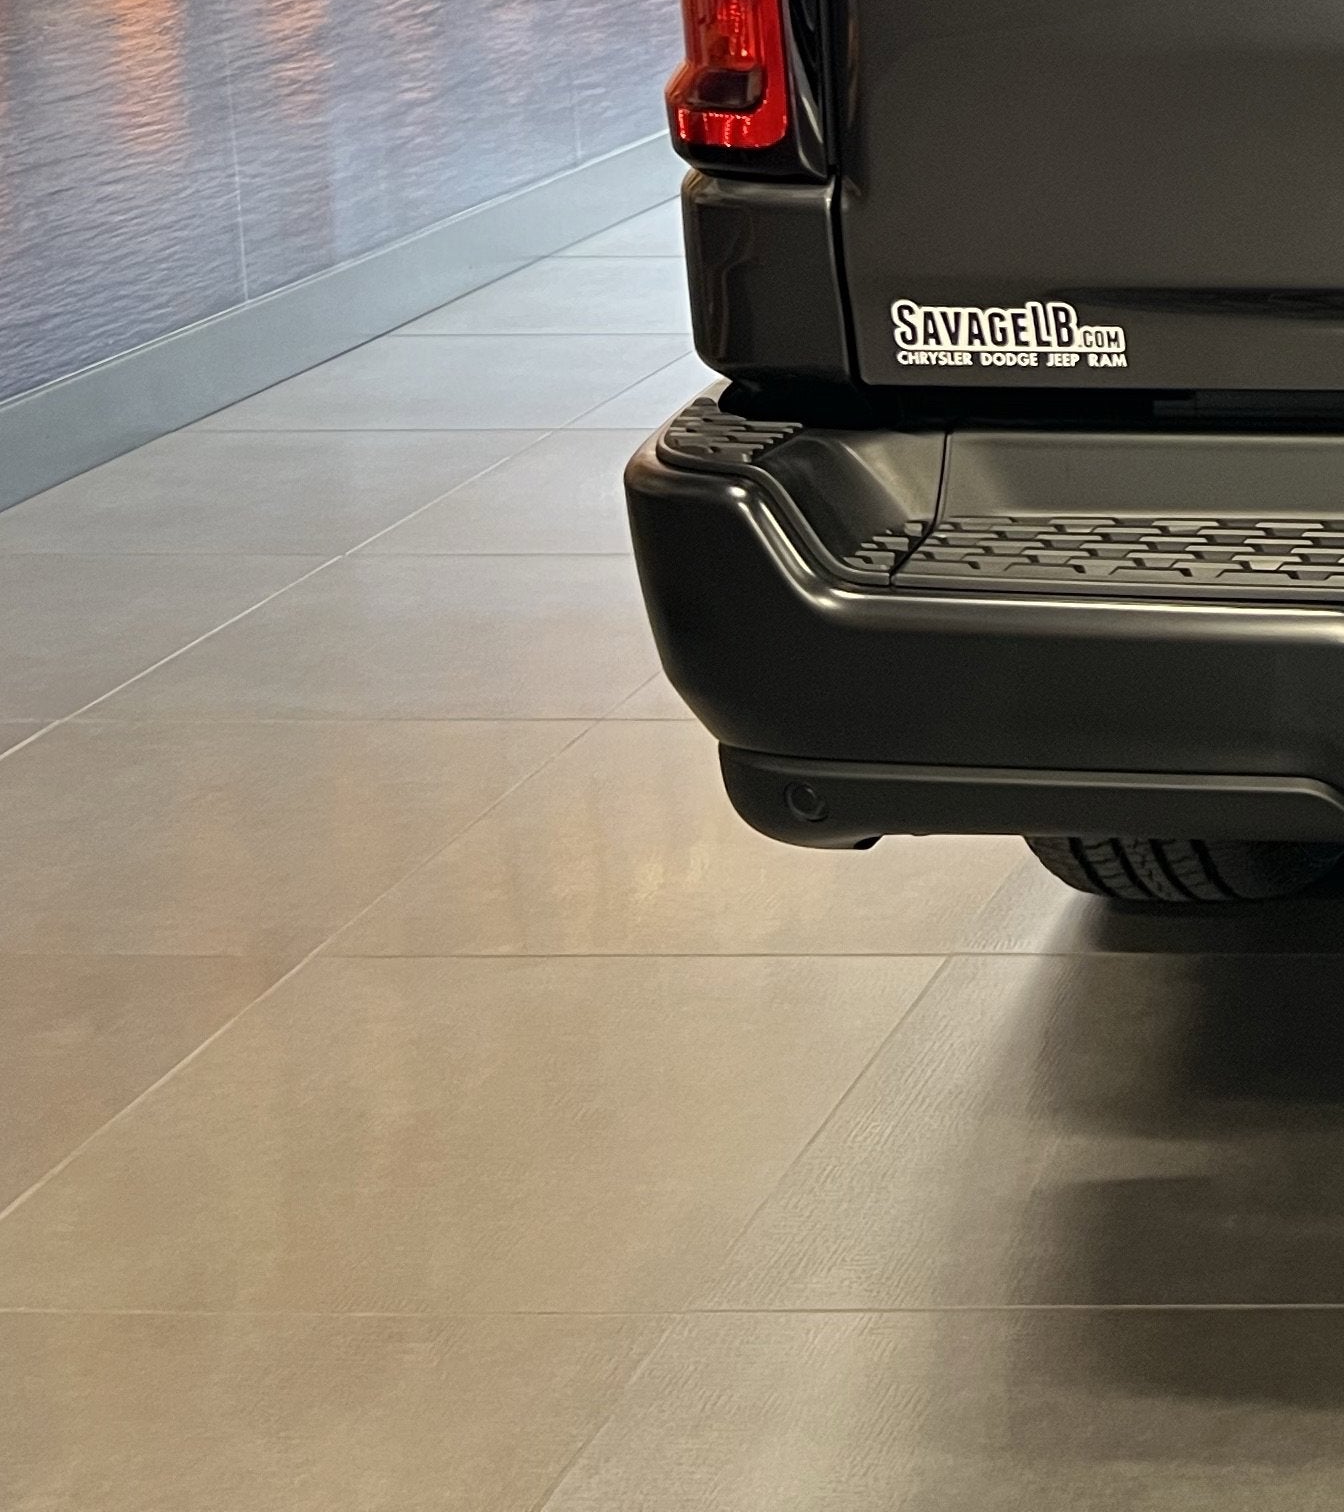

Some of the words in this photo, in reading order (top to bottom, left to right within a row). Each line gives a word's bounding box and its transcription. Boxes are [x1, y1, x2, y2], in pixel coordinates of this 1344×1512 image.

[897, 351, 973, 366] CHRYSLER
[980, 352, 1038, 367] DODGE
[1046, 353, 1080, 367] JEEP
[1087, 354, 1128, 368] RAM
